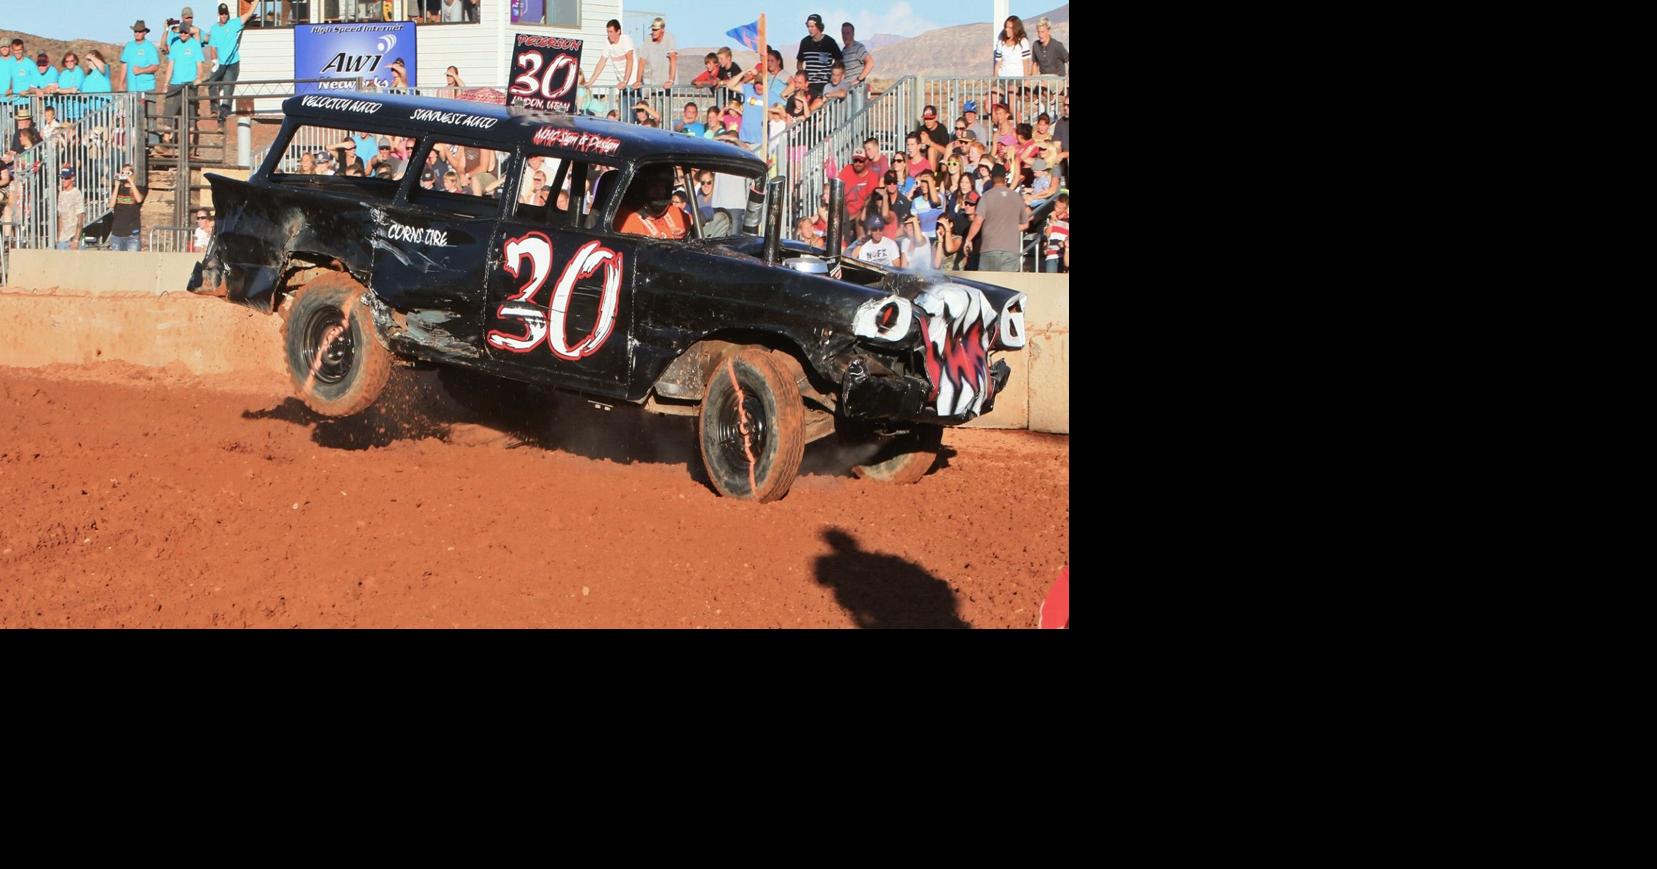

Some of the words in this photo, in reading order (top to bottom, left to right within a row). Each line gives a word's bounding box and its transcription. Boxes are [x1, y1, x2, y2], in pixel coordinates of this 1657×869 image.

[311, 25, 334, 35] High
[334, 24, 363, 34] Speed
[363, 23, 404, 33] Internet
[516, 35, 581, 52] PETERSON
[509, 49, 578, 99] 30
[301, 95, 354, 111] VELOCITY
[348, 100, 383, 115] AUTO
[462, 115, 498, 129] AUTO
[558, 131, 579, 148] Sign
[588, 135, 621, 154] Design
[425, 229, 448, 247] TIRE
[487, 231, 624, 361] 30
